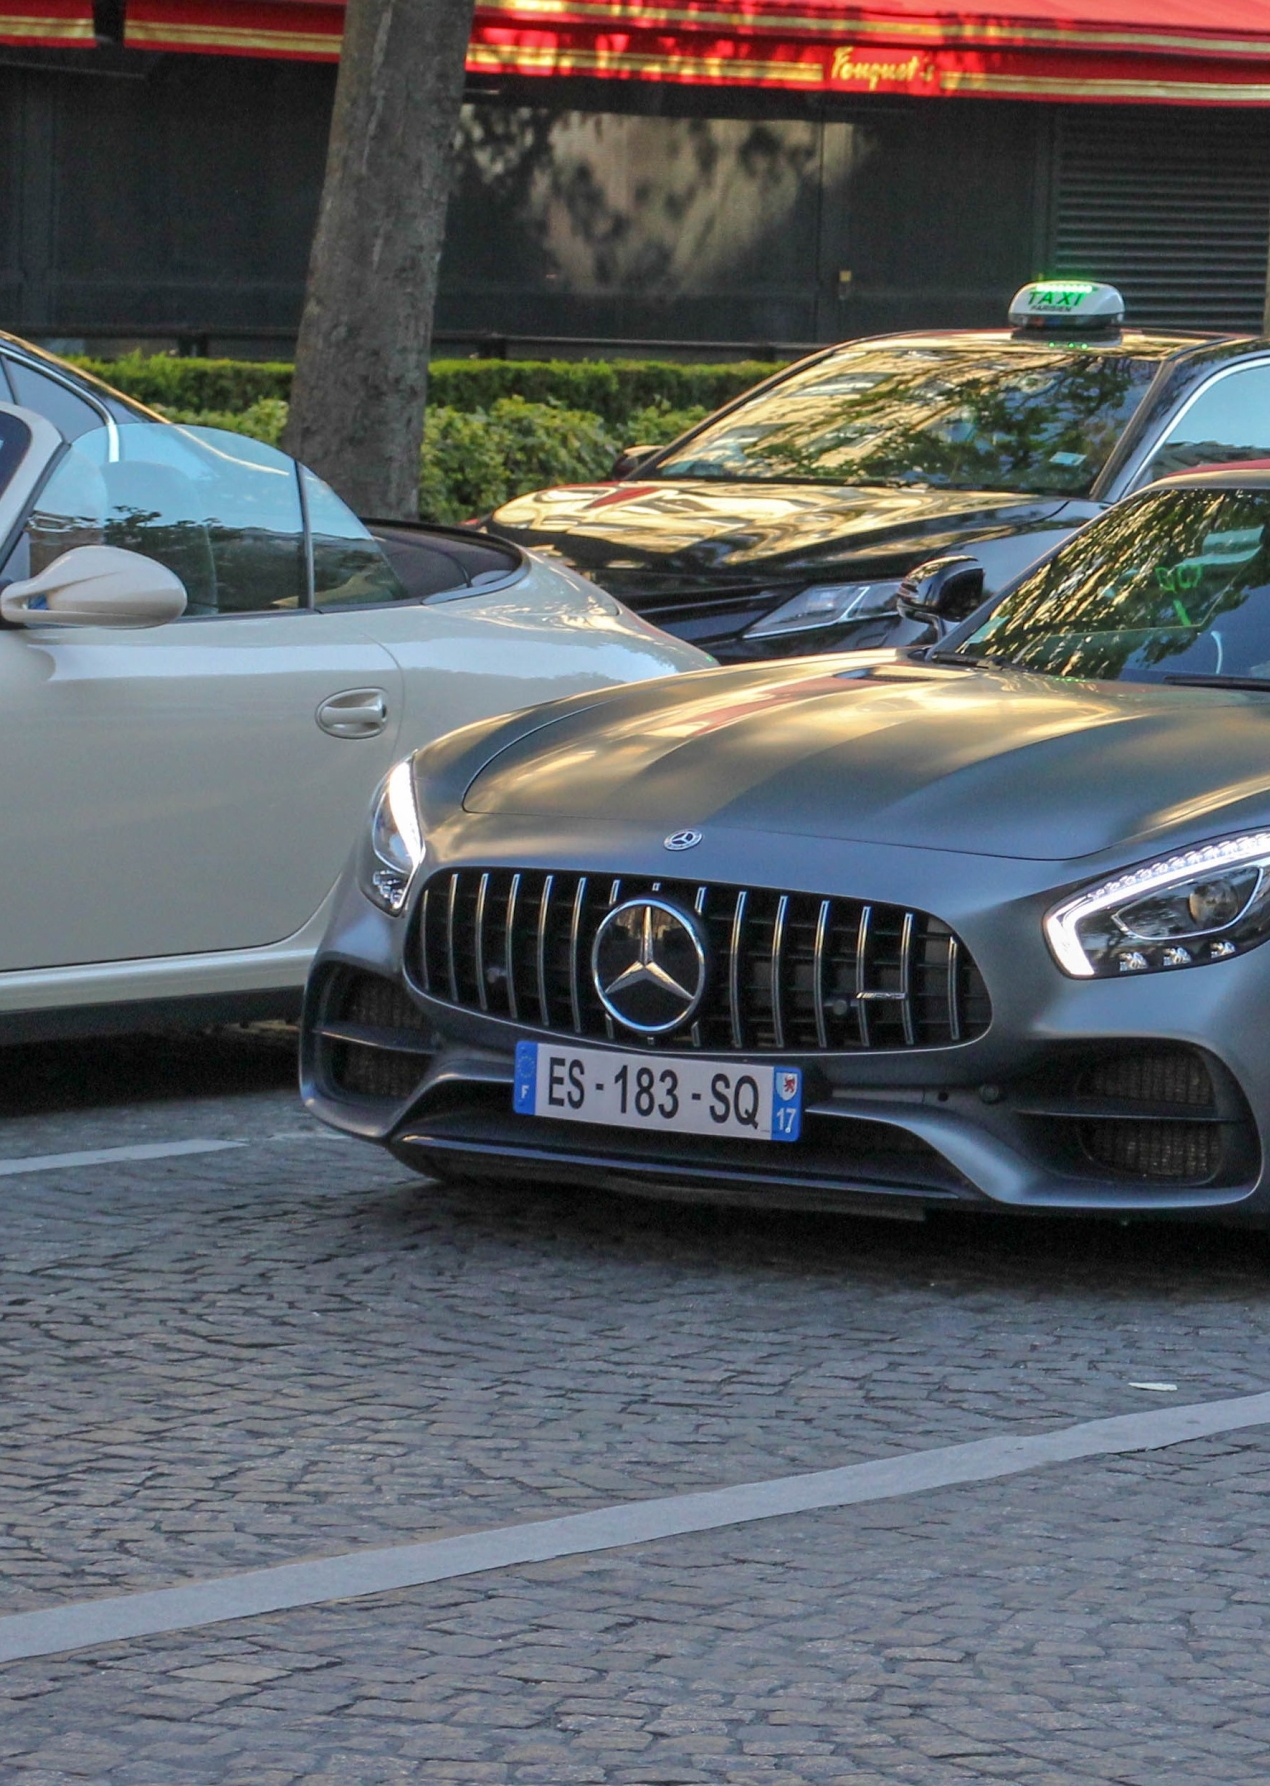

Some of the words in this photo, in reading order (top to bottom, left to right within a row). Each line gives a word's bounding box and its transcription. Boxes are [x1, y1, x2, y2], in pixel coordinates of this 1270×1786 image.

[831, 46, 935, 91] Fouquet's
[1028, 291, 1085, 306] TAXI
[521, 1085, 530, 1099] F
[776, 1107, 796, 1134] 17
